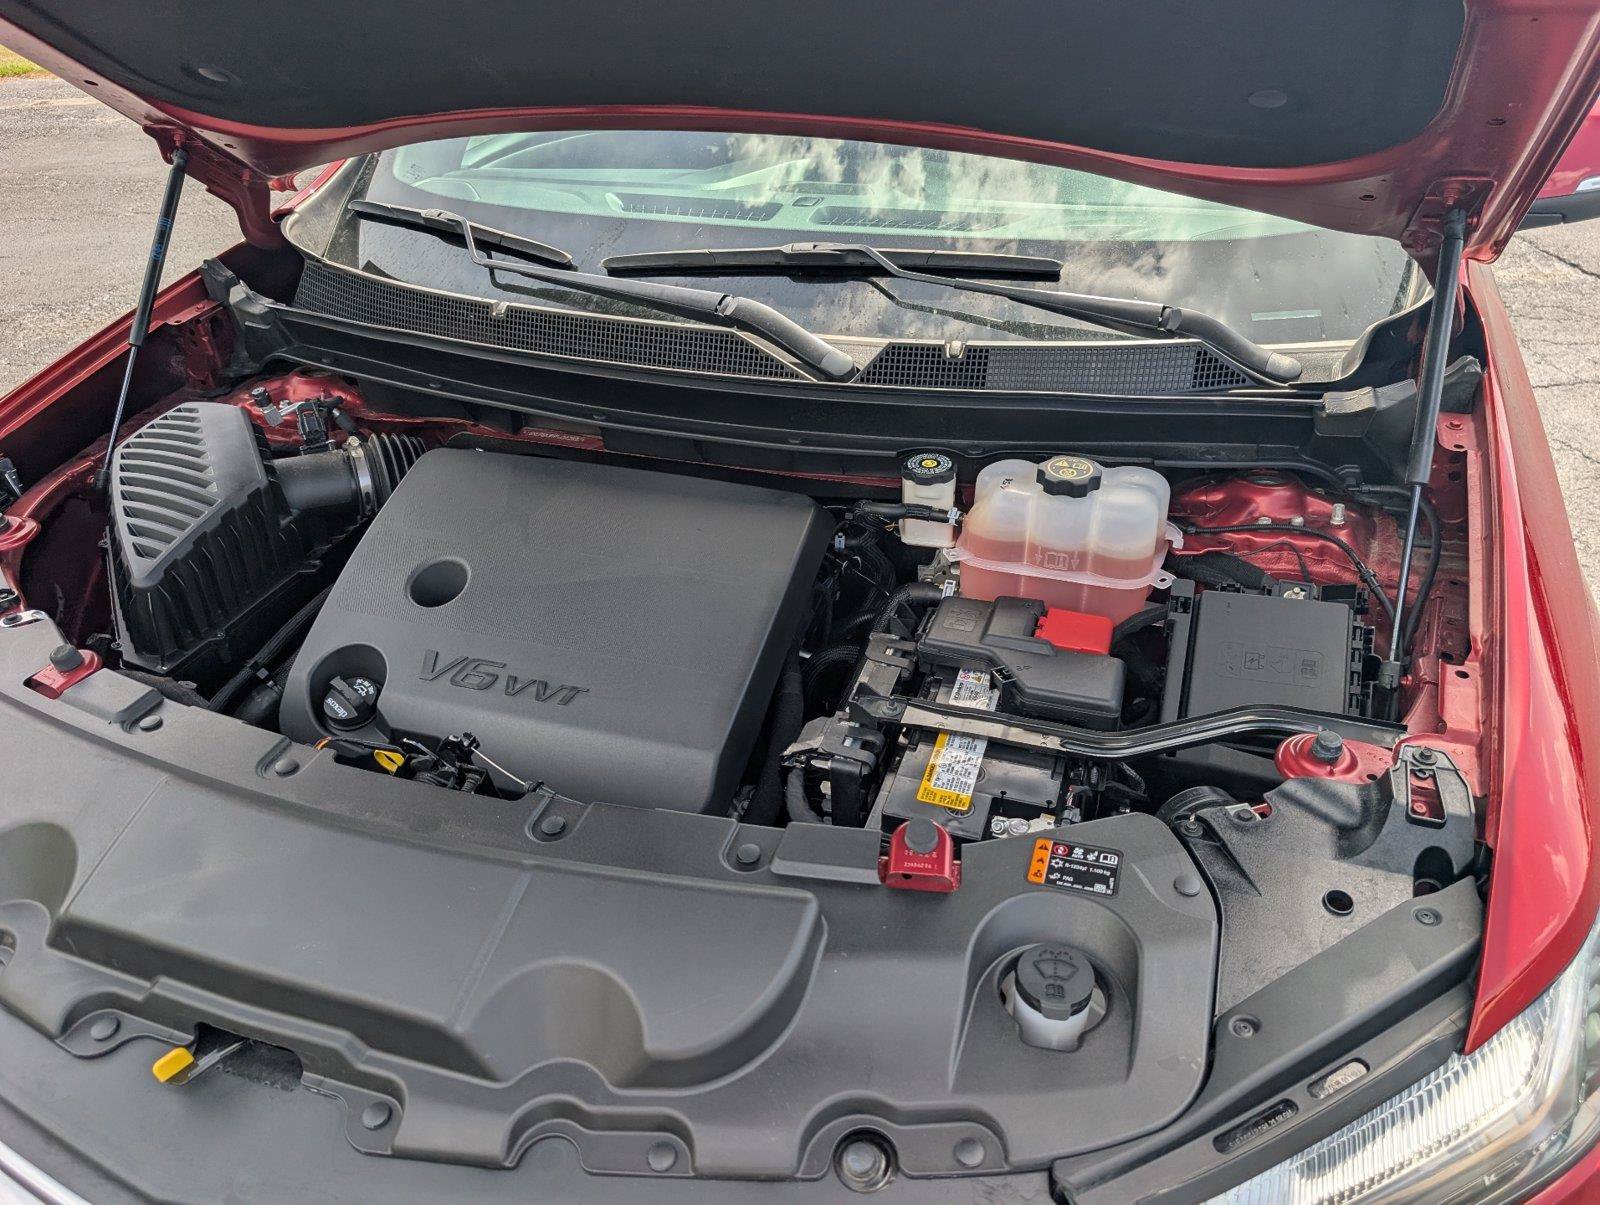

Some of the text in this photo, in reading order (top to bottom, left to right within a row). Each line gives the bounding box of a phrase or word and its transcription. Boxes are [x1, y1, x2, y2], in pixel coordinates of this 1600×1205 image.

[419, 649, 590, 706] V6 VVT
[326, 697, 348, 718] dexos
